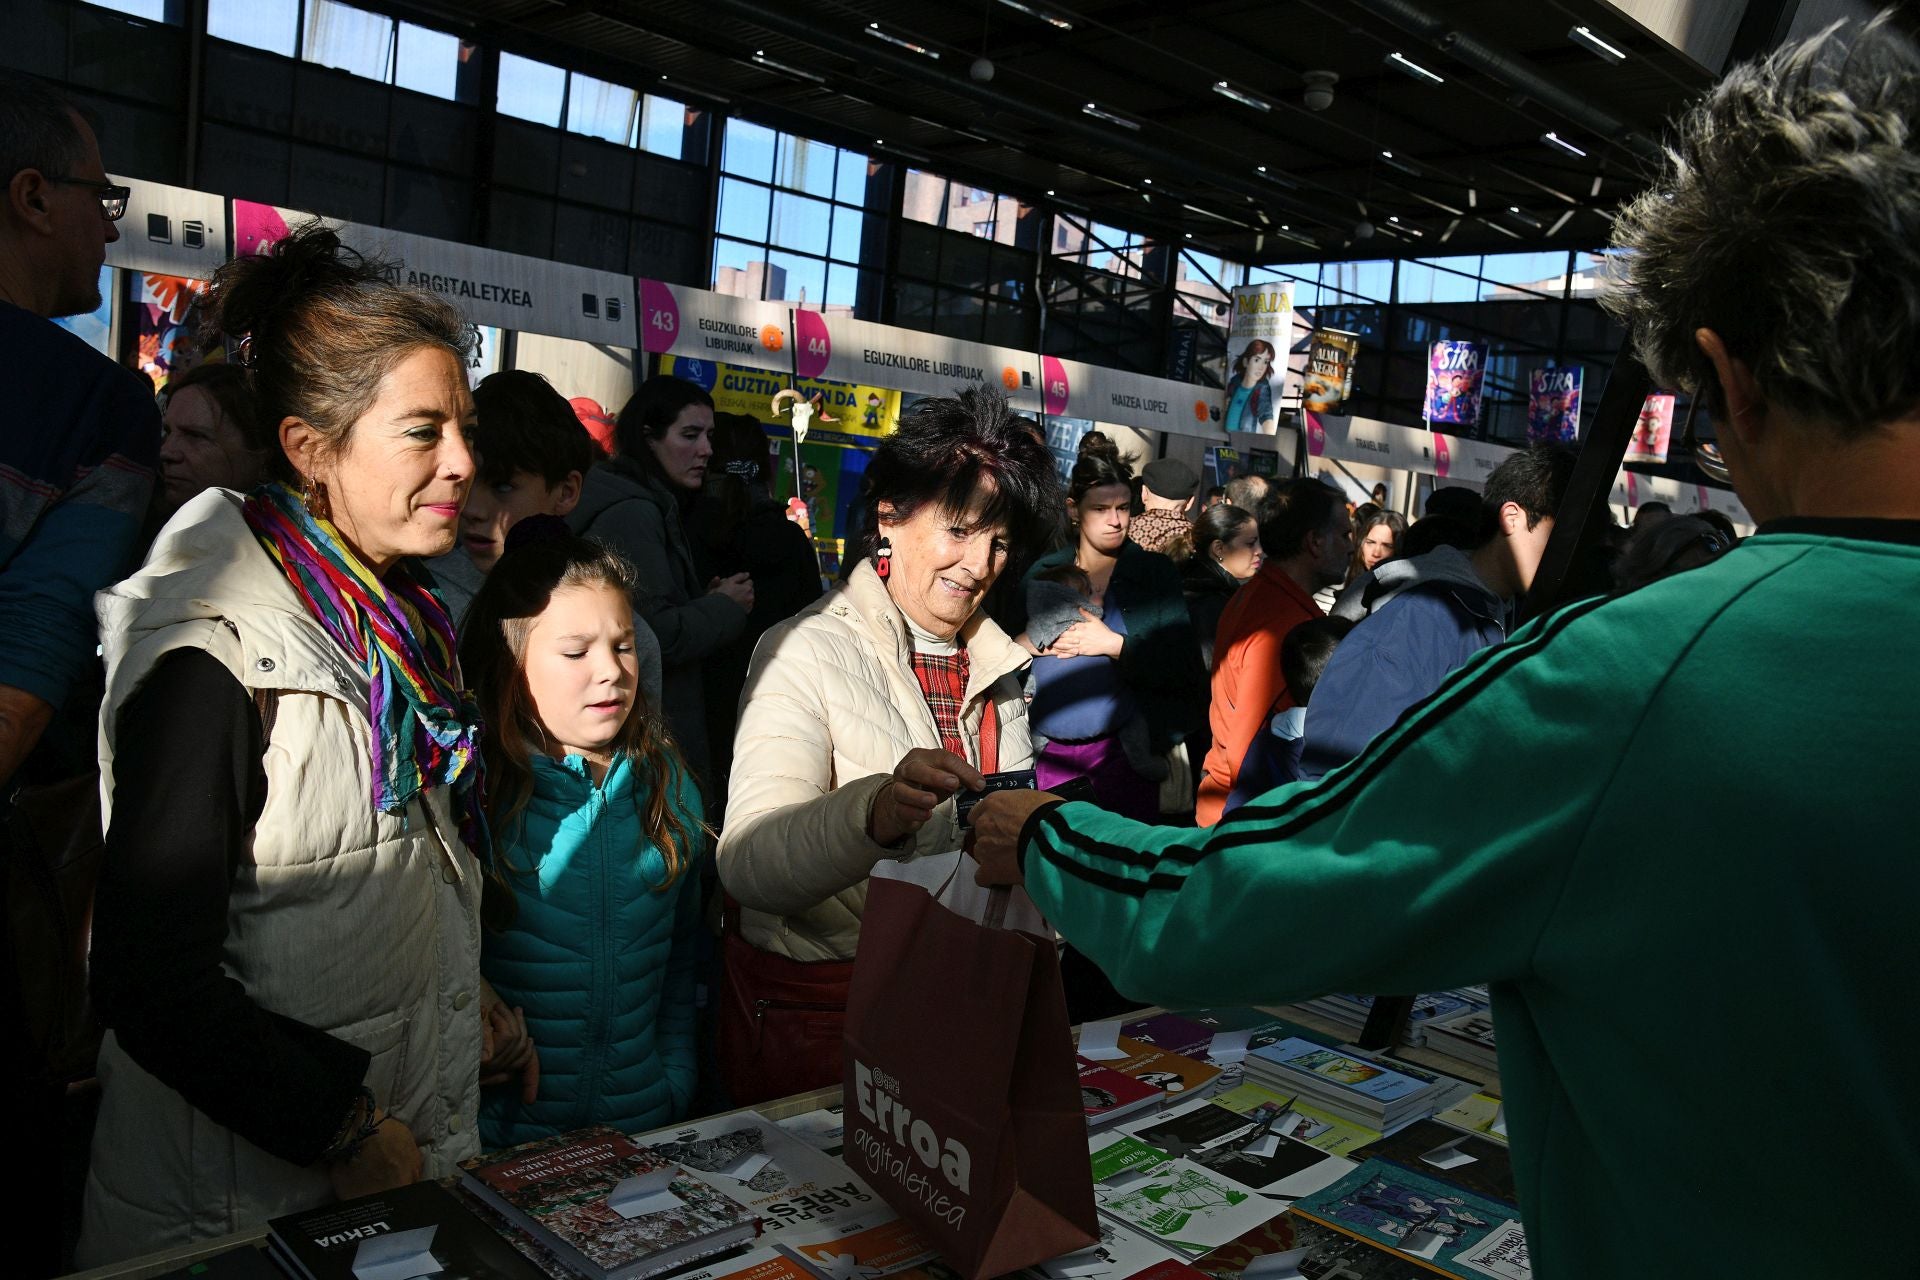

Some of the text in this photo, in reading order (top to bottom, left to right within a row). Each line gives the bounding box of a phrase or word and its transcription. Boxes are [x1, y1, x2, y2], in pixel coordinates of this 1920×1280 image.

[408, 270, 533, 309] ARGITALETXEA
[1238, 292, 1291, 314] MAIA
[651, 310, 674, 332] 43
[698, 317, 758, 339] EGUZKILORE
[705, 335, 754, 355] LIBURUAK
[807, 335, 828, 358] 44
[863, 348, 984, 382] EGUZKILORE LIBURUAK
[723, 374, 780, 396] GUZTIA
[835, 391, 857, 408] DA
[1050, 380, 1066, 399] 45
[1111, 392, 1169, 414] HAIZEA LOPEZ
[855, 1059, 971, 1196] Erroa
[502, 1142, 614, 1178] GABRIEL ARESTI
[565, 1151, 616, 1171] BILBON
[854, 1127, 968, 1232] argitaletxea
[763, 1193, 873, 1233] GABRIE
[312, 1221, 391, 1248] LEKUA
